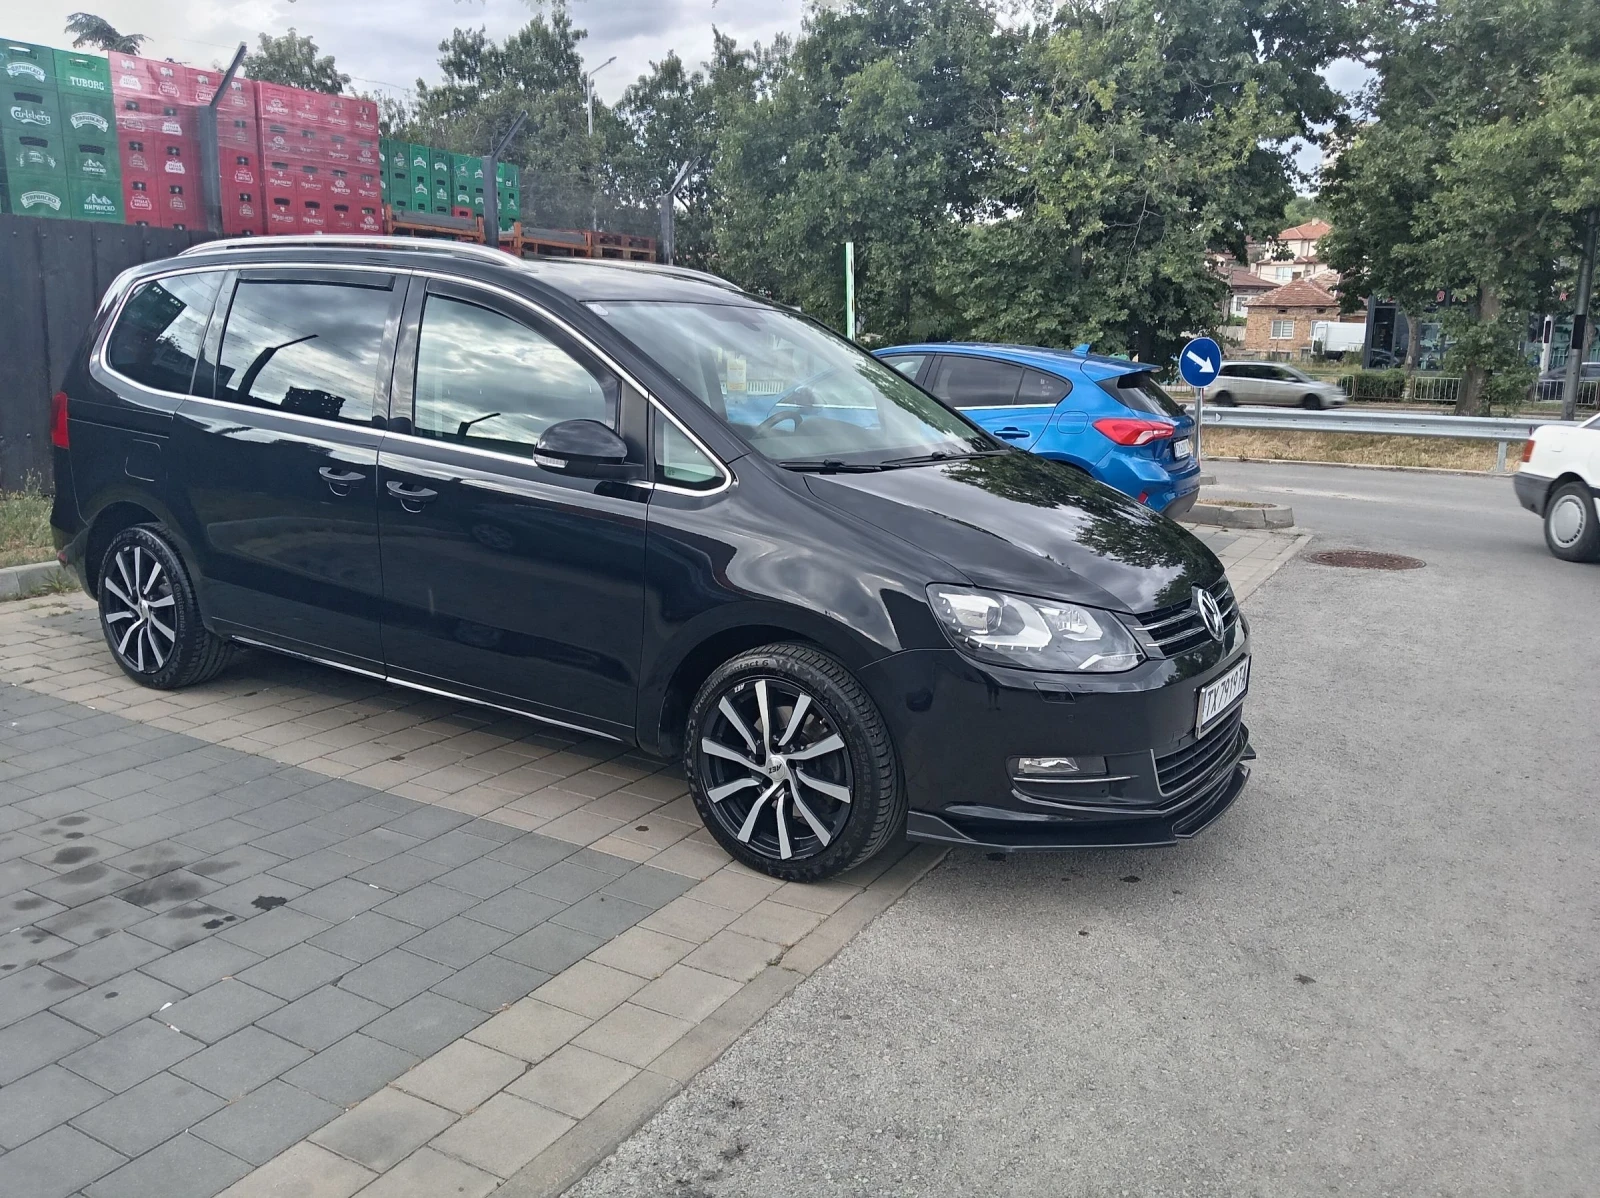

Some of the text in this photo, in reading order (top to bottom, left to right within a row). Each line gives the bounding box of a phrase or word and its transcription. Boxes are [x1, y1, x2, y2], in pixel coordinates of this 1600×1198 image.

[69, 76, 105, 91] TUBORG
[10, 106, 51, 125] Carlsberg
[83, 203, 116, 212] ПИРИНСКО
[761, 659, 769, 667] 6
[1206, 685, 1220, 718] TX
[1217, 670, 1239, 709] 7919
[768, 763, 783, 774] AEZ
